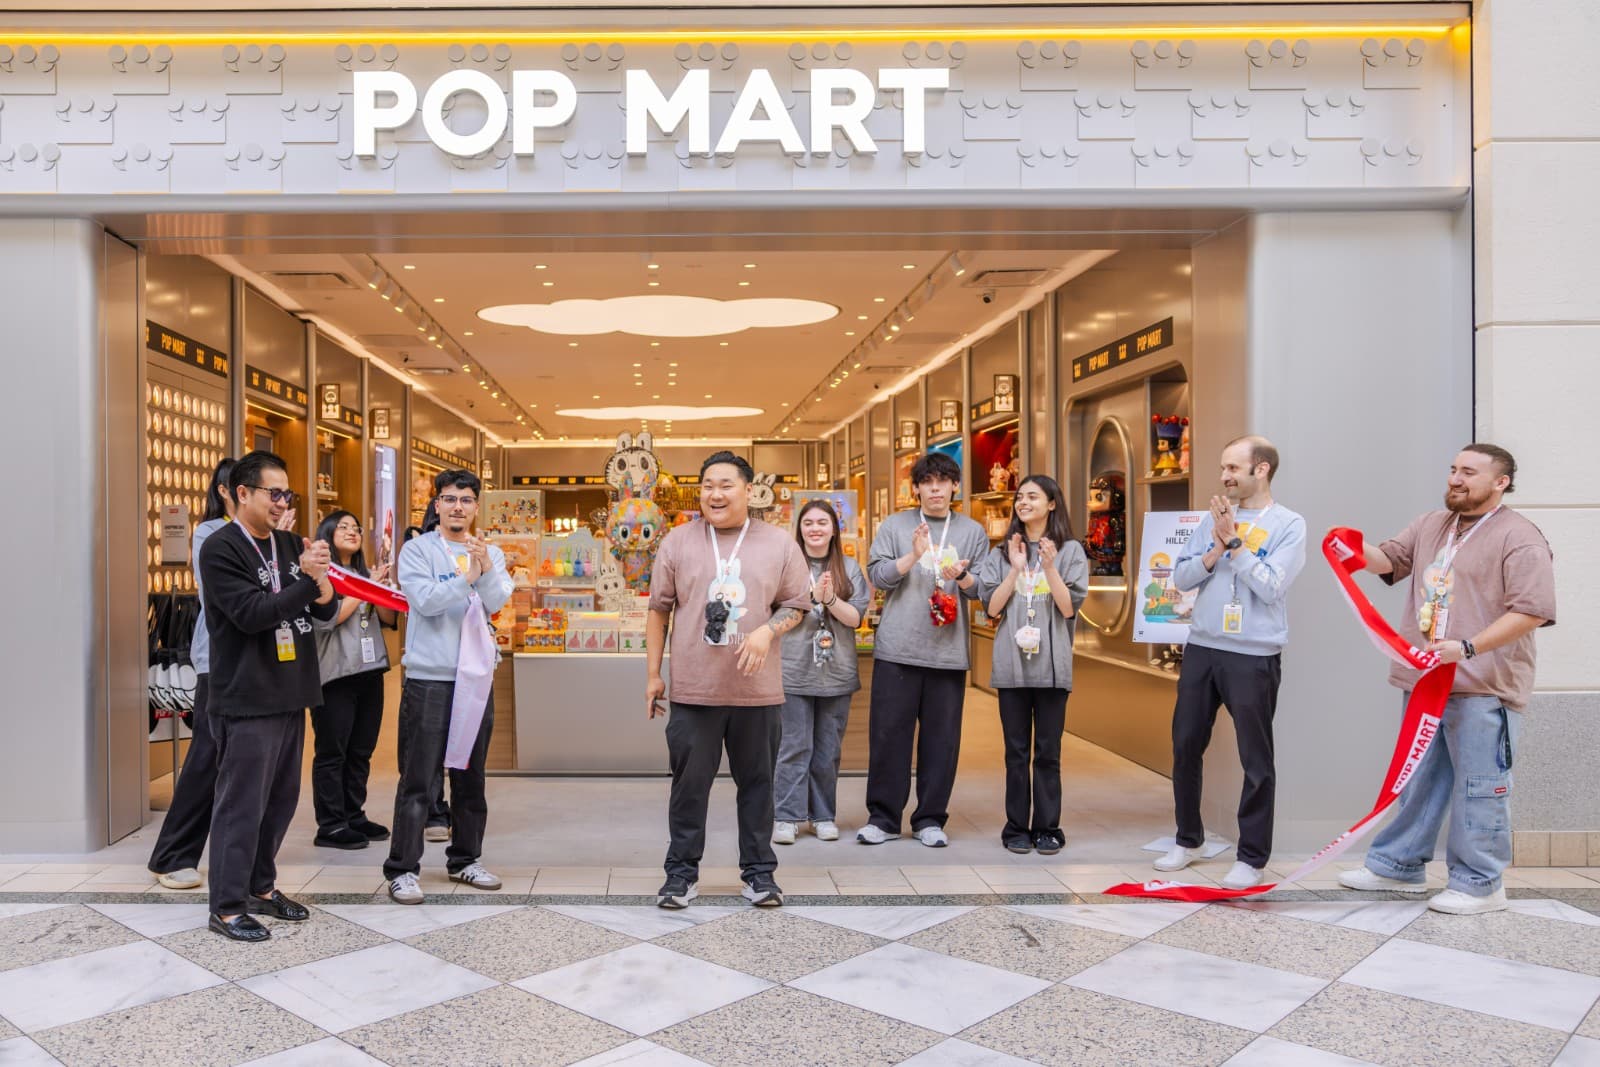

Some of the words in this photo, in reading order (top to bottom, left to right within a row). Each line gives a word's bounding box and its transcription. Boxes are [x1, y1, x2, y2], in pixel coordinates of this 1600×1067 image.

[353, 70, 578, 157] POP
[626, 68, 950, 155] MART
[1411, 718, 1438, 761] MART
